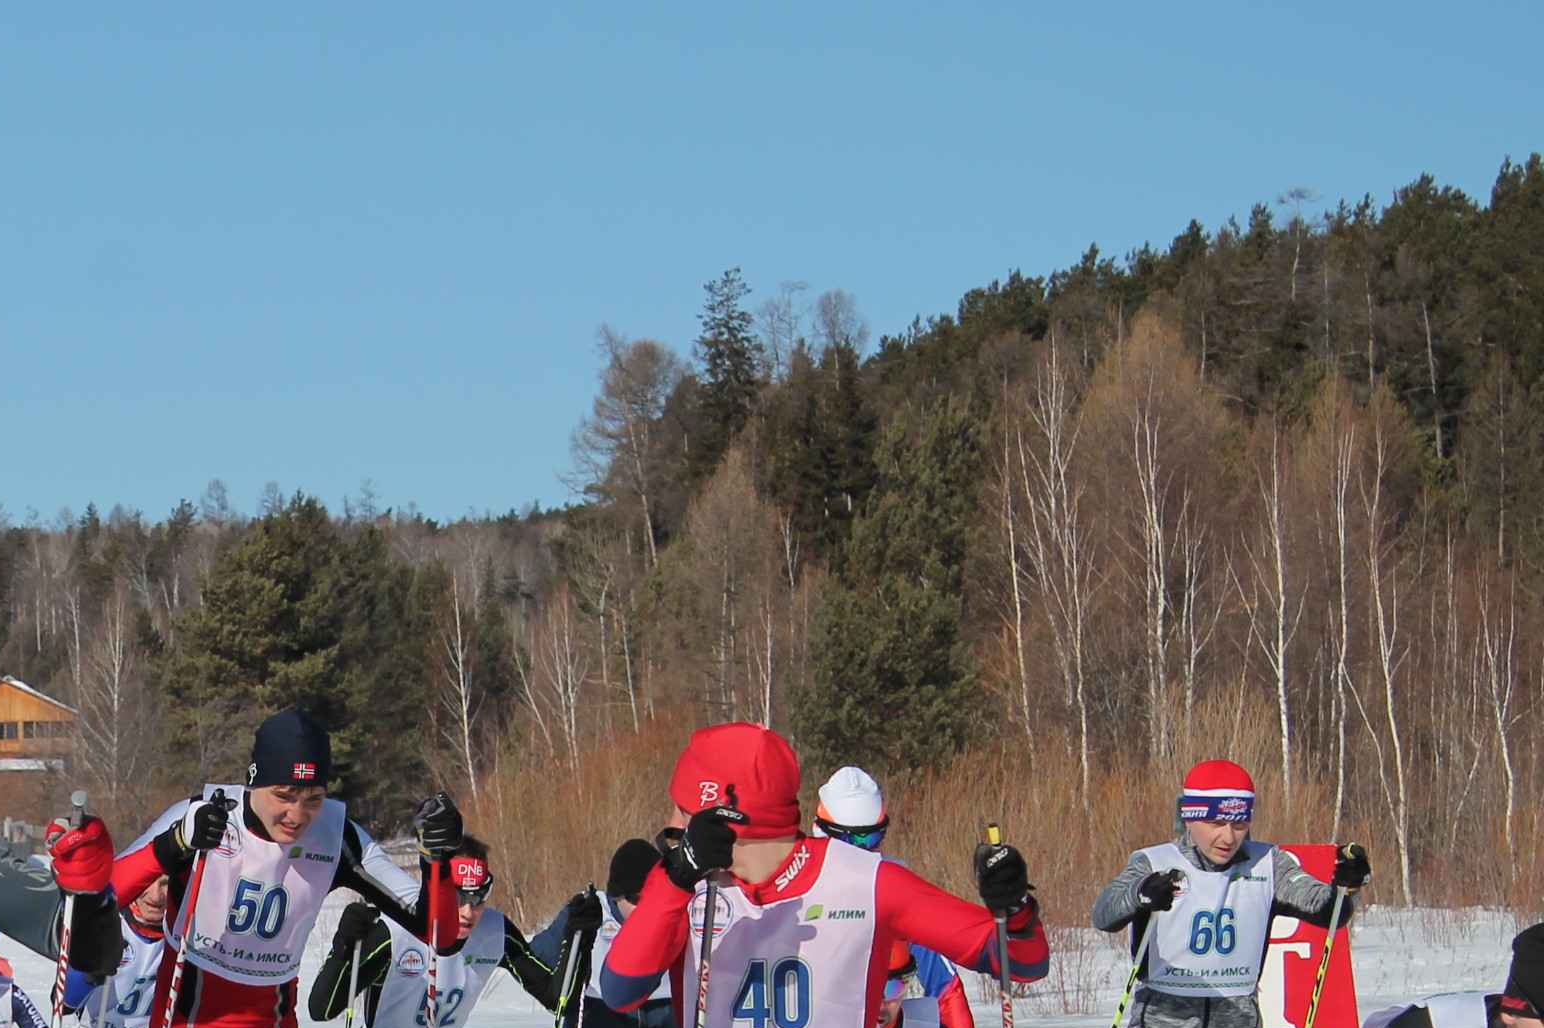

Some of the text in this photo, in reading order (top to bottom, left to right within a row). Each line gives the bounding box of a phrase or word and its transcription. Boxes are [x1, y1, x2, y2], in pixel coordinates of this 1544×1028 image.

[305, 852, 334, 863] ИЛИМ
[458, 859, 483, 878] DNB
[228, 878, 288, 940] 50
[828, 909, 866, 920] ИЛИМ
[1190, 908, 1236, 955] 66
[416, 986, 465, 1027] 52
